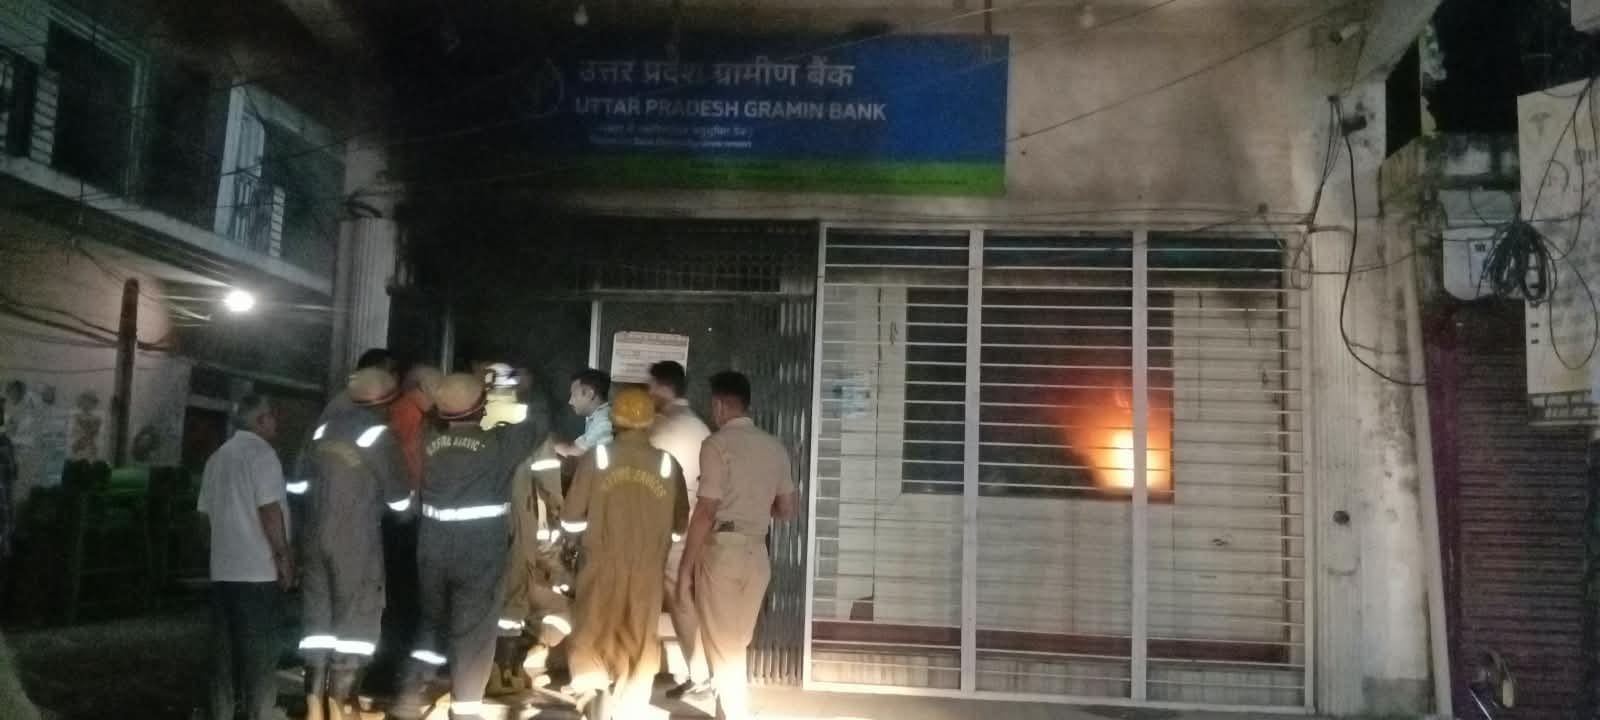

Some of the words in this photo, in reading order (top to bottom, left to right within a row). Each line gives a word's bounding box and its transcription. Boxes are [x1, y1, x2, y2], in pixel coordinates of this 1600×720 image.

[578, 60, 633, 82] उत्तर
[712, 56, 799, 87] ग्रामीण
[807, 55, 856, 87] बैंक
[576, 96, 641, 116] UTTAR
[645, 97, 739, 118] PRADESH
[743, 101, 825, 120] GRAMIN
[828, 103, 888, 121] BANK
